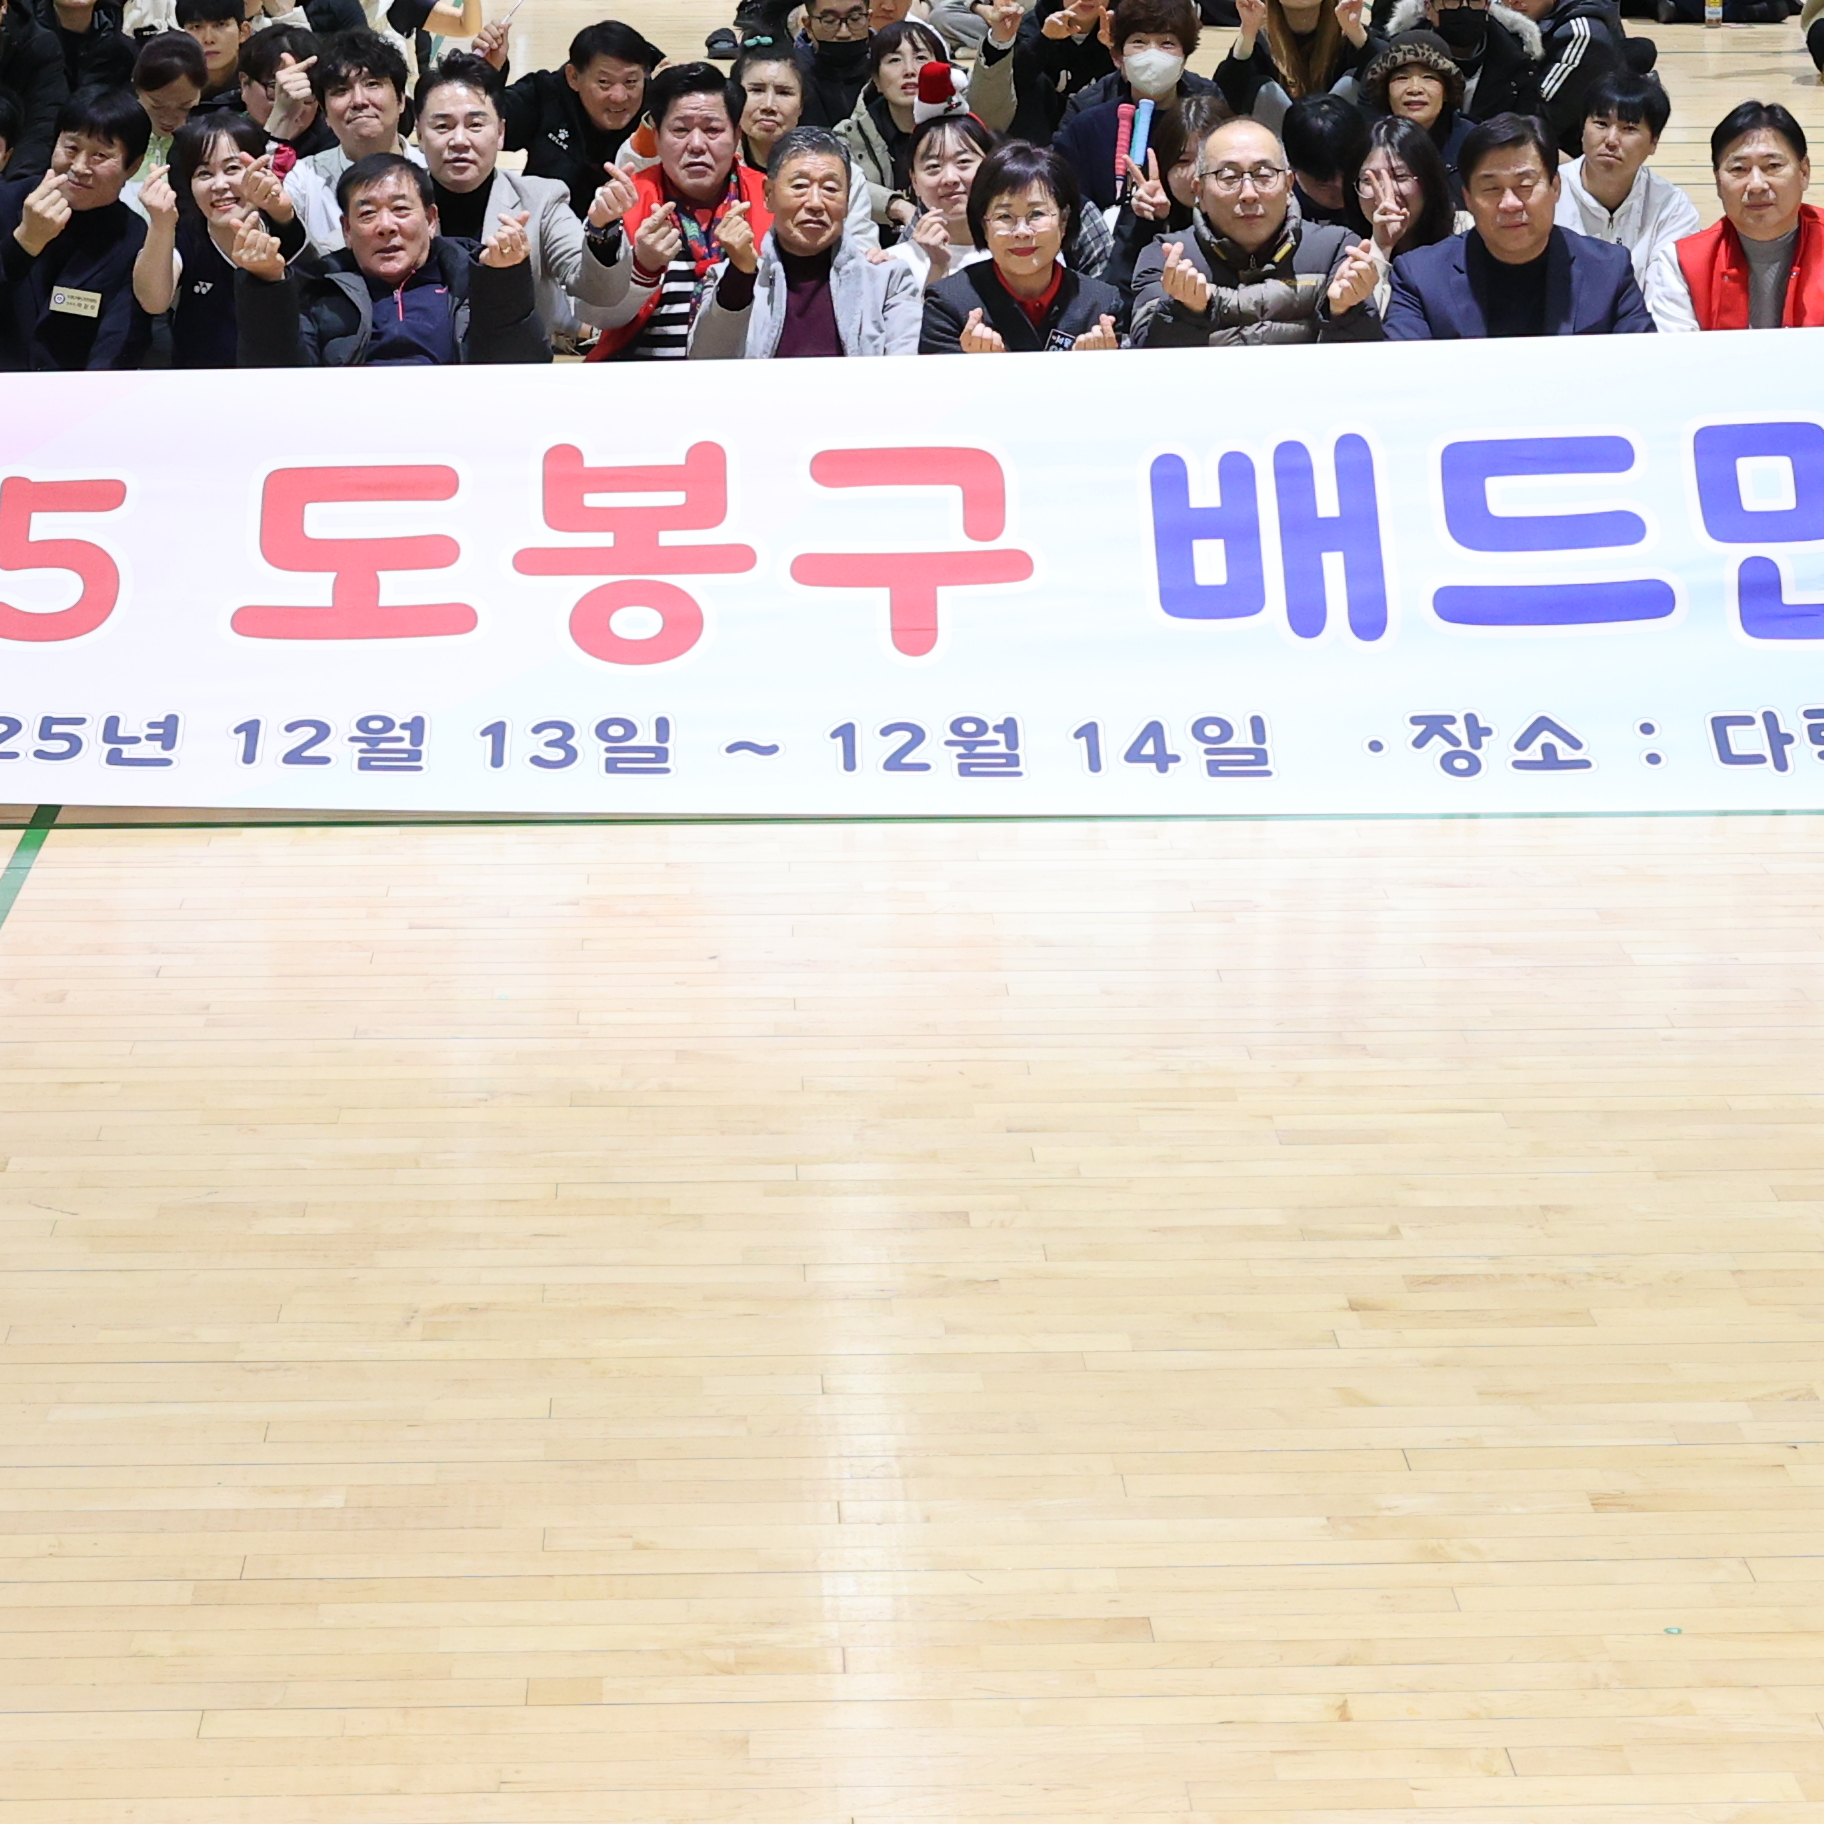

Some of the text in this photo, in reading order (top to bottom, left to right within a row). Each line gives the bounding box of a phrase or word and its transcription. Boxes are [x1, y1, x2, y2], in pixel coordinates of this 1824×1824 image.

[231, 441, 1034, 666] 도봉구
[234, 715, 426, 771] 12월
[481, 716, 672, 774] 13일
[831, 716, 1021, 777] 12월
[1074, 716, 1268, 776] 14일
